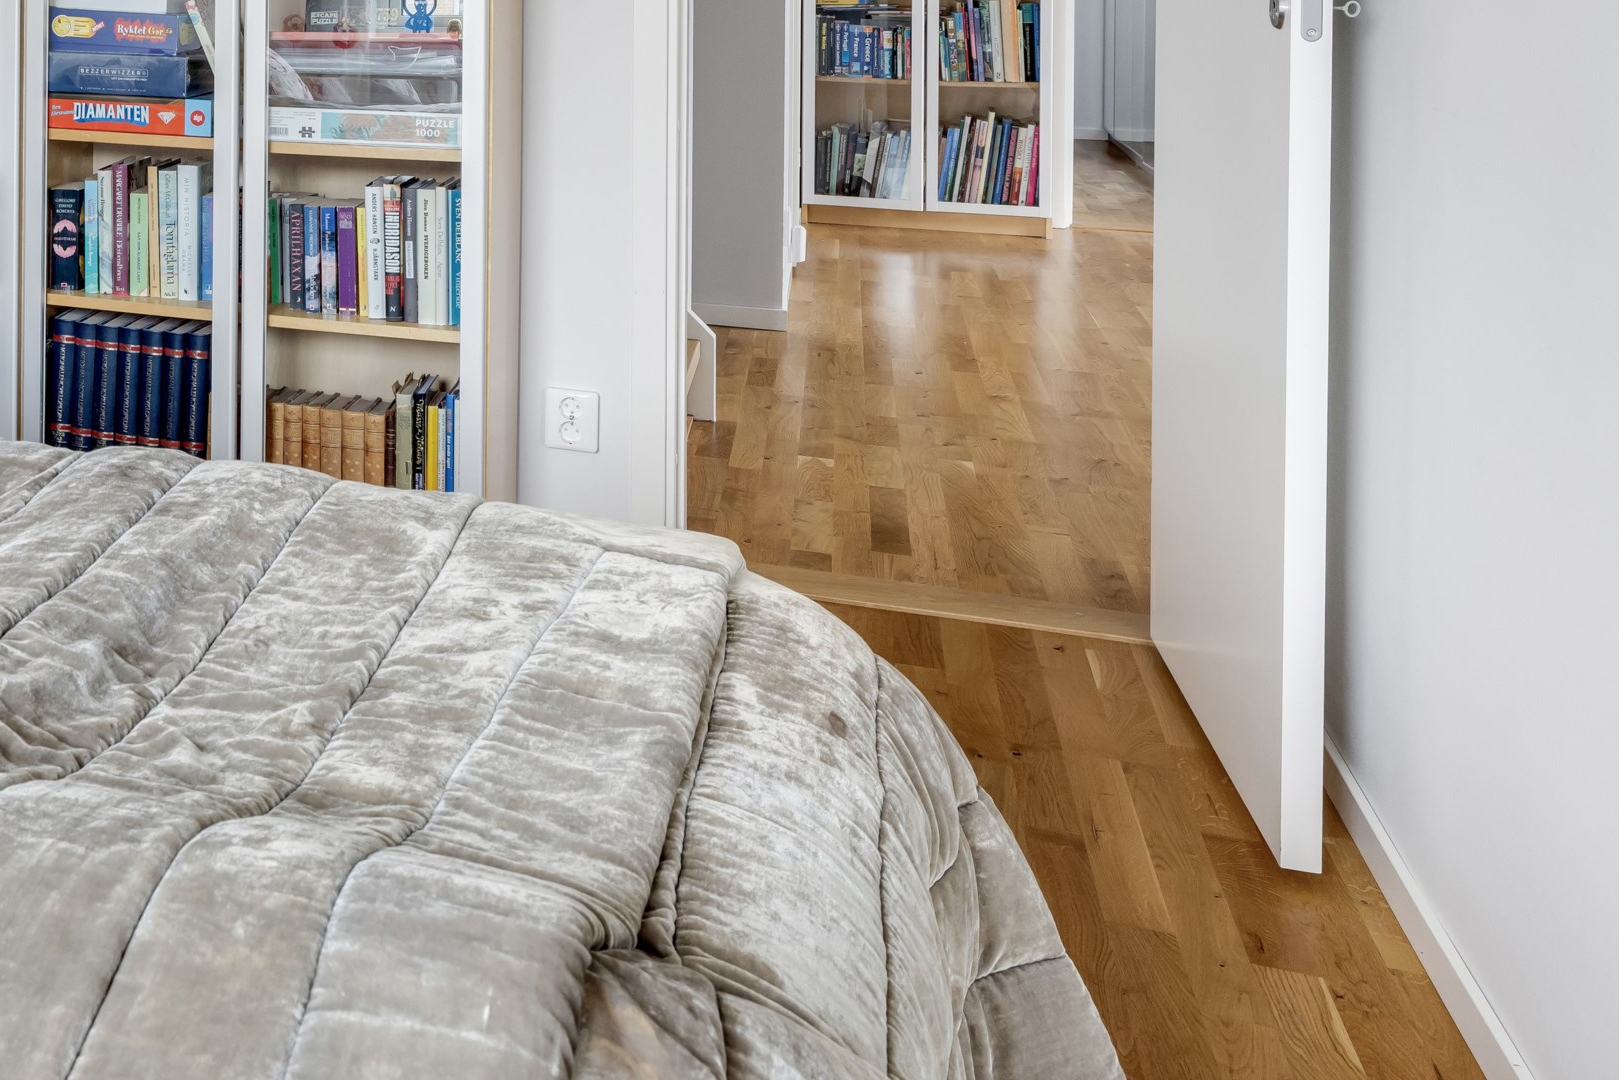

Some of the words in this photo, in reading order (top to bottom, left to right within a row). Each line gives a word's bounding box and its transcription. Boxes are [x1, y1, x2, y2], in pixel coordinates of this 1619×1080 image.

[117, 23, 146, 35] Ryktet
[80, 68, 141, 76] BEZZERWIZZER
[73, 101, 150, 125] DIAMANTEN
[415, 119, 455, 129] PUZZLE
[415, 129, 441, 137] 1000
[115, 170, 123, 206] MARGARET
[115, 207, 123, 237] DRABBLE
[291, 210, 302, 291] APRILHÄXAN
[57, 343, 66, 422] NATIONALENCYKLOPEDIN
[122, 353, 131, 433] NATIONALENCYKLOPEDIN
[189, 360, 198, 440] NATIONALENCYKLOPEDIN
